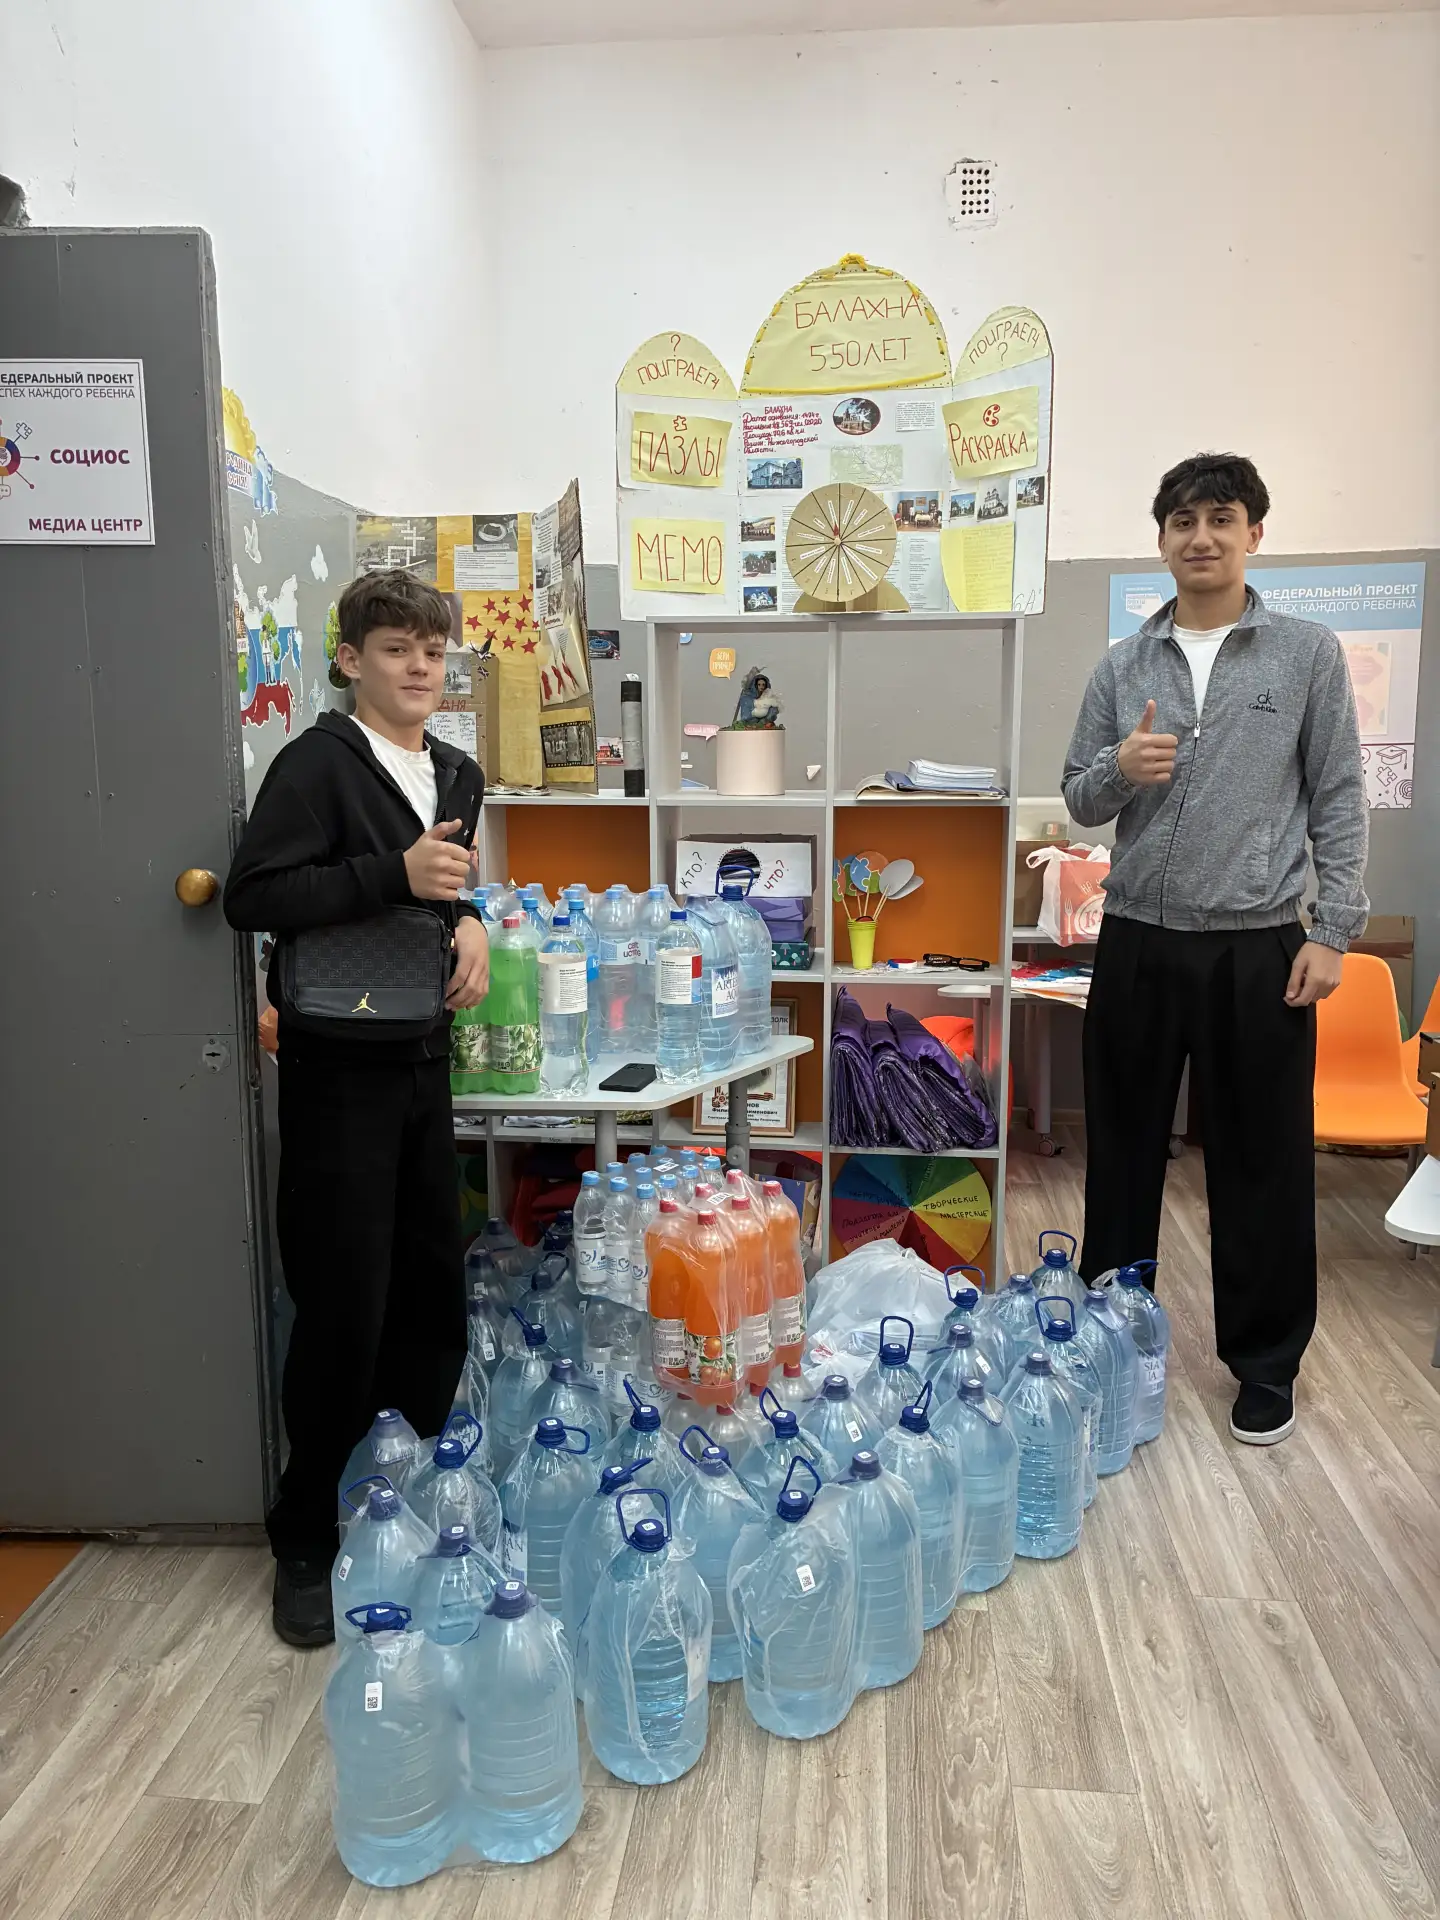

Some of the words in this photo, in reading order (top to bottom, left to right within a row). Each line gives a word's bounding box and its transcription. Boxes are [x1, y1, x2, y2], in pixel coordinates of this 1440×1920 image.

[795, 294, 923, 330] БАЛАХНА
[0, 372, 83, 385] ЕДЕРАЛЬНЫЙ
[87, 374, 134, 384] ПРОЕКТ
[0, 388, 26, 398] СПЕХ
[28, 388, 83, 399] КАЖДОГО
[86, 388, 135, 398] РЕБЕНКА
[50, 449, 130, 467] СОЦИОС
[638, 430, 723, 478] ПАЗЛЫ
[28, 518, 87, 534] МЕДИА
[91, 518, 143, 534] ЦЕНТР
[637, 532, 723, 586] МЕМО
[1261, 584, 1363, 600] ФЕДЕРАЛЬНЫЙ
[1366, 583, 1418, 595] ПРОЕКТ
[1300, 600, 1360, 614] КАЖДОГО
[1363, 599, 1417, 611] РЕБЕНКА
[437, 699, 467, 712] ДНЯ
[679, 851, 707, 890] КТО?
[763, 859, 790, 891] ЧТО?
[922, 1195, 979, 1211] ТВОРЧЕСКИЕ
[939, 1209, 989, 1219] МАСТЕРСКИЕ
